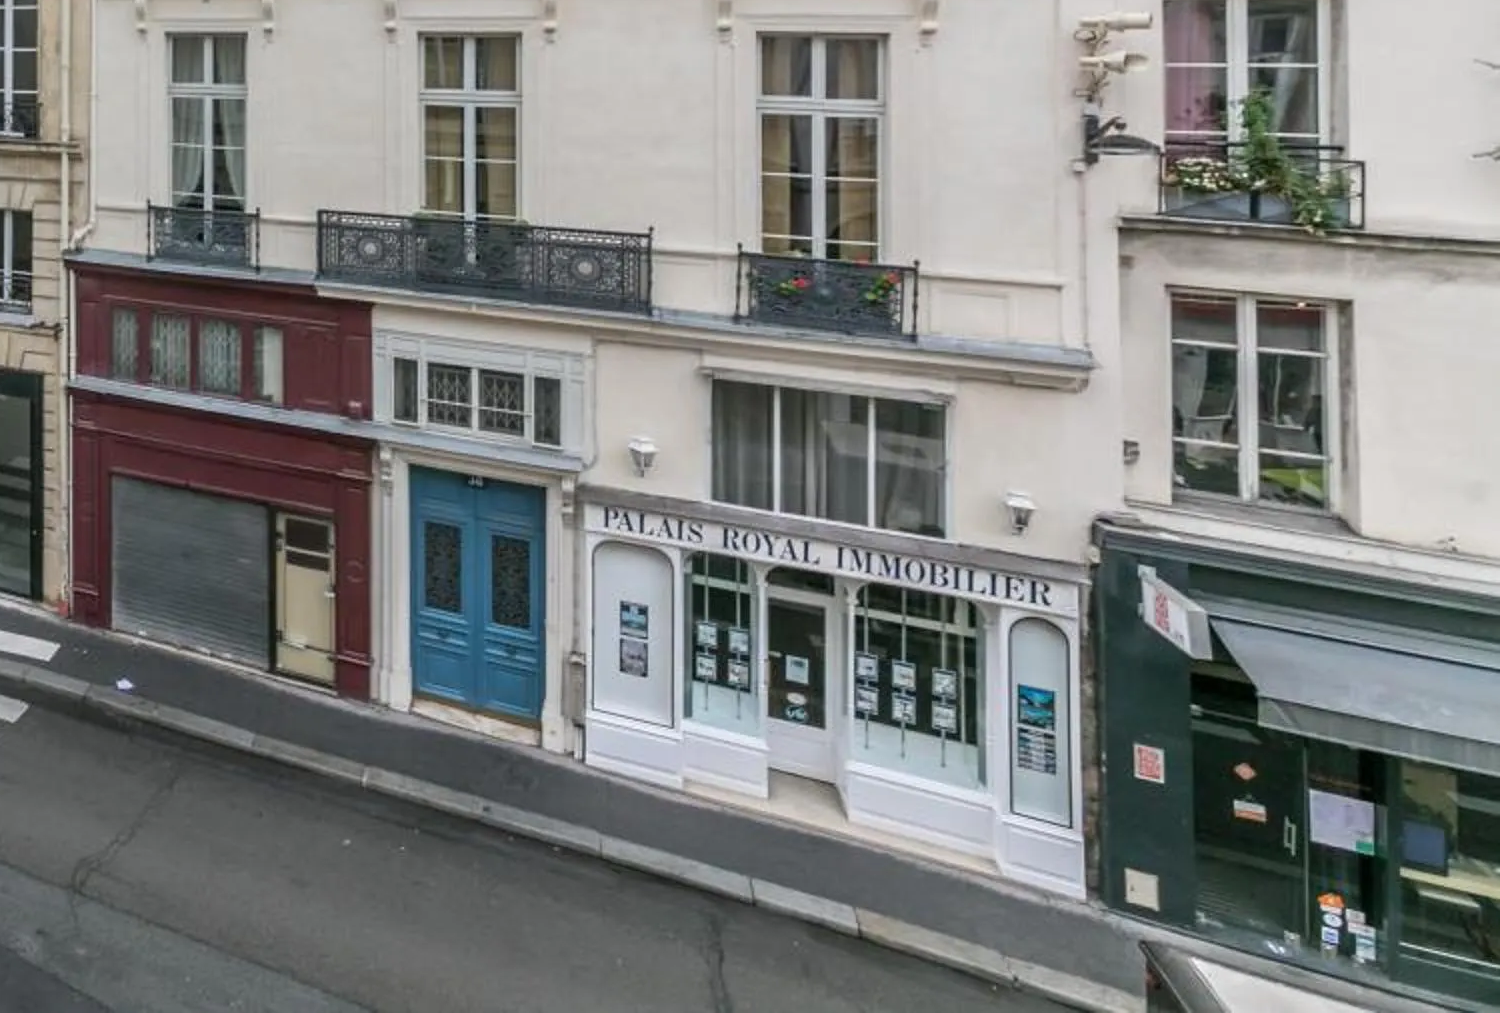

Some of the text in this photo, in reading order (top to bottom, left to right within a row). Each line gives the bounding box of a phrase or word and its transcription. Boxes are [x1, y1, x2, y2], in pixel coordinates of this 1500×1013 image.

[603, 506, 1053, 607] PALAIS ROYAL IMMOBILIER
